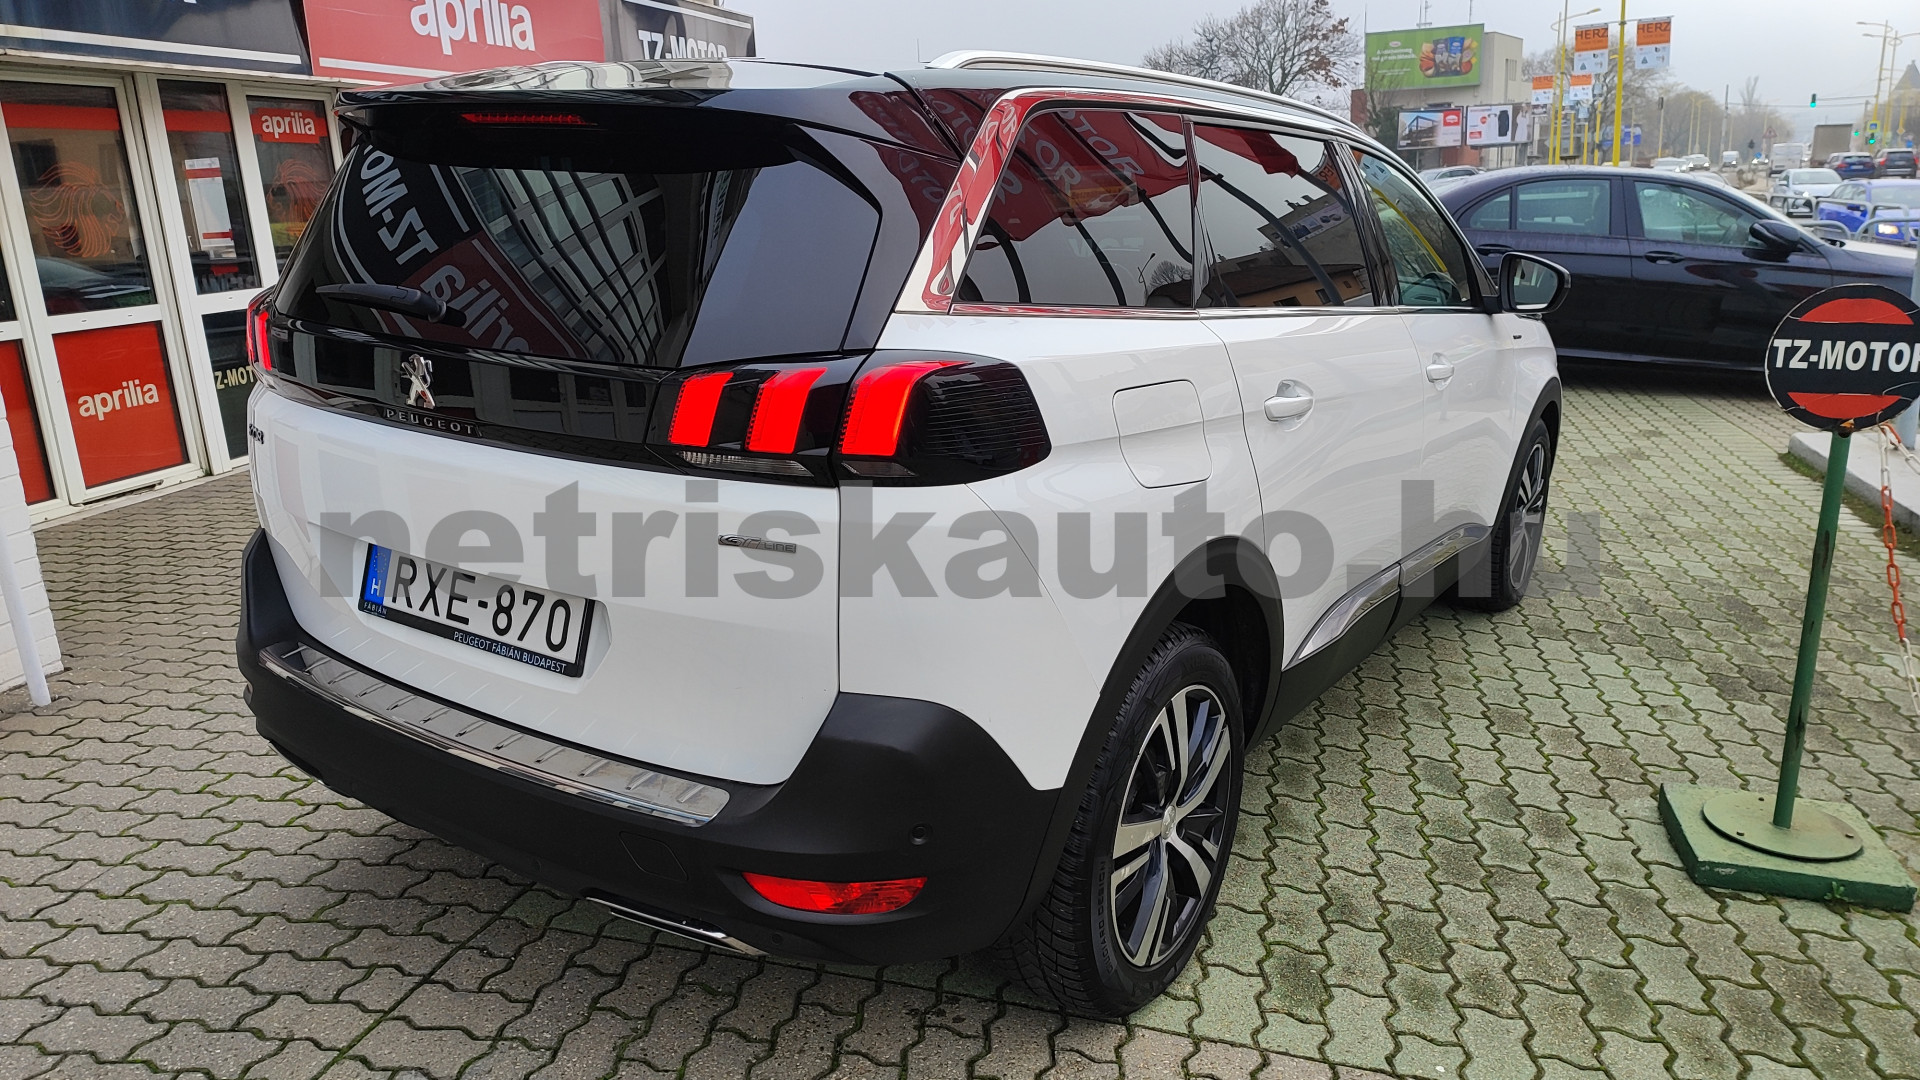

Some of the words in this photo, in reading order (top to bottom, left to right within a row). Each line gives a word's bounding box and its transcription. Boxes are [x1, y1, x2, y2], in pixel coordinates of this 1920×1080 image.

[411, 0, 536, 56] aprilia
[1576, 28, 1608, 40] HERZ
[1637, 22, 1670, 33] HERZ
[261, 111, 316, 139] aprilia
[214, 366, 255, 390] Z-MOT
[78, 379, 160, 421] aprilia
[386, 408, 474, 434] PEUGEOT
[370, 577, 382, 596] H
[391, 556, 572, 652] RXE-870
[453, 631, 492, 651] PEUGEOT
[491, 642, 521, 661] FÁBIÁN
[522, 651, 567, 674] BUDAPEST
